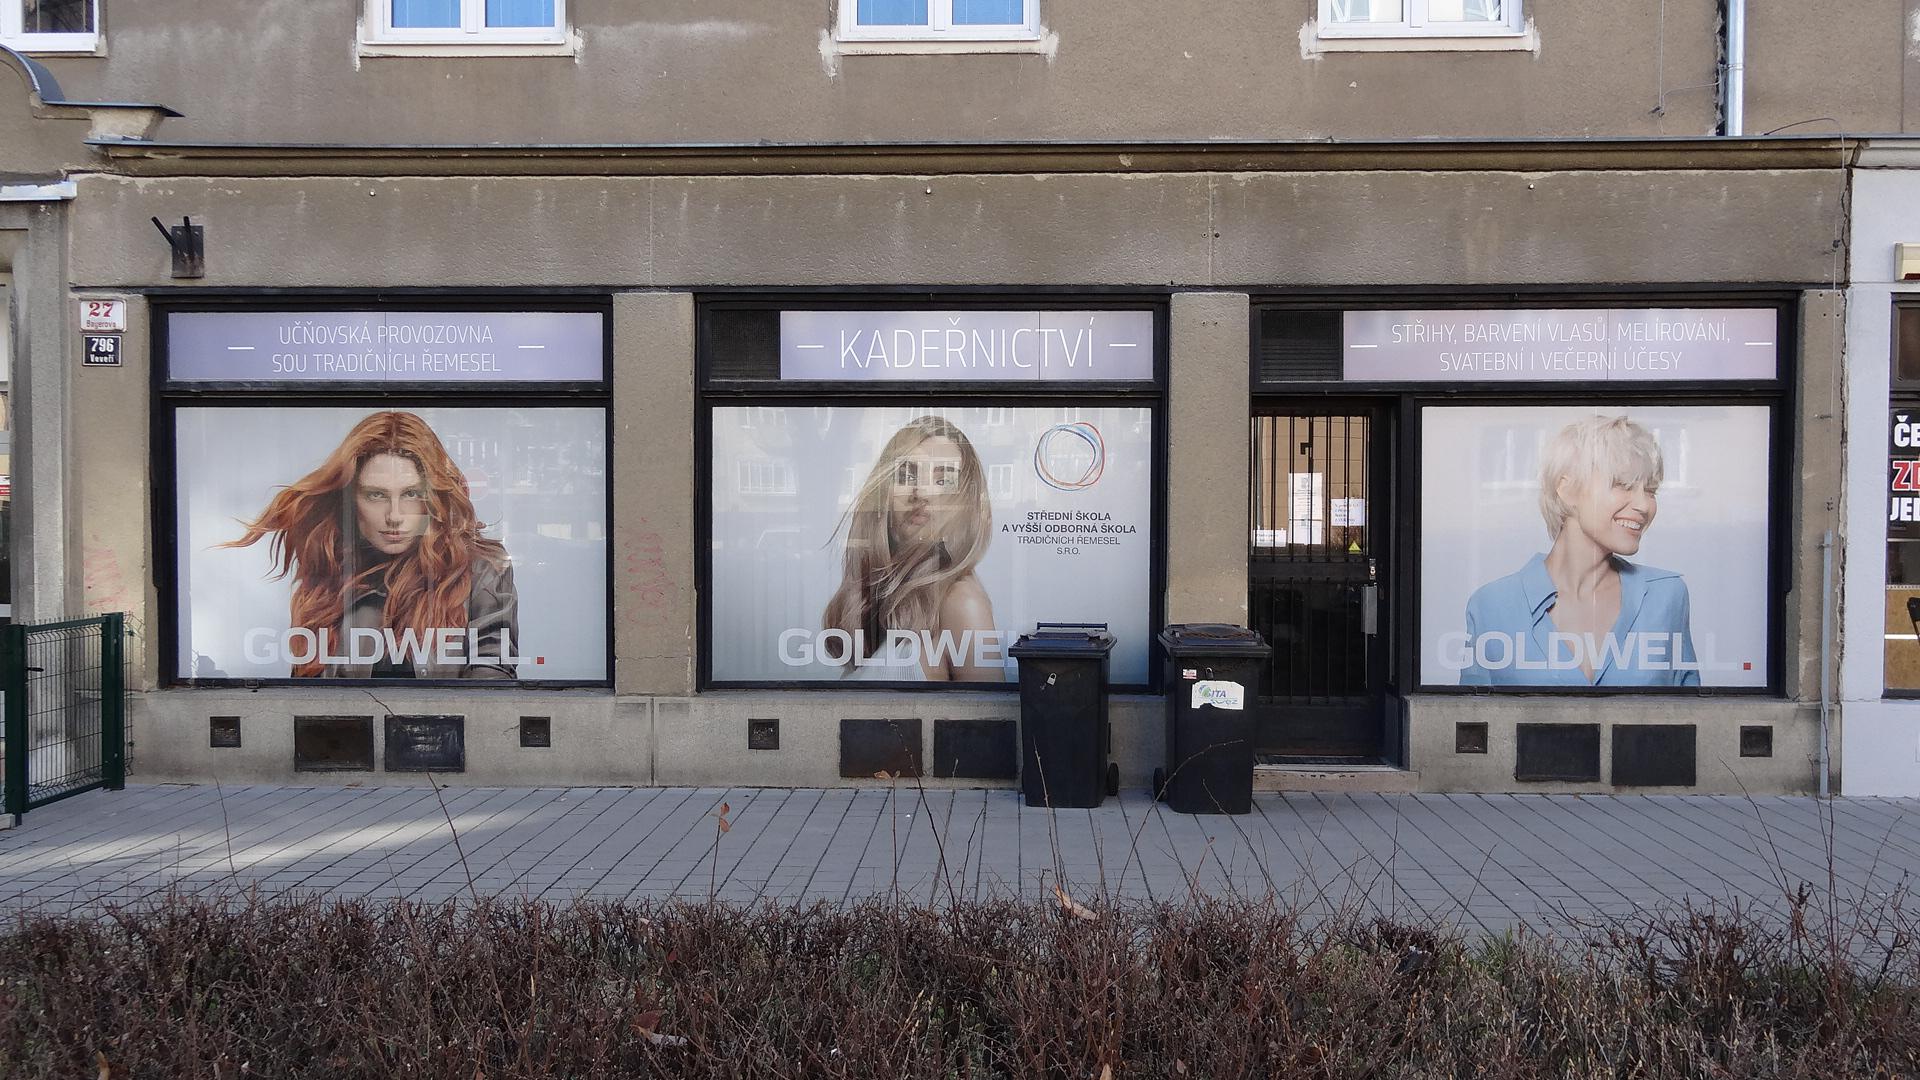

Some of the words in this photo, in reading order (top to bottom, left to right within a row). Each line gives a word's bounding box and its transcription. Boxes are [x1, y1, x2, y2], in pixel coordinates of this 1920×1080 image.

[89, 302, 114, 317] 27
[279, 320, 372, 344] UČŇOVSKÁ
[377, 325, 494, 344] PROVOZOVNA
[1391, 318, 1457, 345] STŘIHY,
[1464, 318, 1542, 343] BARVENÍ
[1617, 316, 1731, 343] MELÍROVÁNÍ,
[91, 337, 114, 352] 796
[840, 316, 1095, 369] KADEŘNICTVÍ
[272, 353, 307, 373] SOU
[313, 348, 415, 372] TRADIČNÍCH
[422, 349, 502, 372] ŘEMESEL
[1439, 347, 1524, 372] SVATEBNÍ
[1531, 352, 1535, 371] I
[1541, 346, 1617, 371] VEČERNÍ
[1624, 346, 1683, 371] ÚČESY
[1027, 510, 1073, 521] STŘEDNÍ
[1075, 510, 1112, 521] ŠKOLA
[1001, 524, 1010, 533] A
[1012, 522, 1042, 533] VYŠŠÍ
[1044, 523, 1098, 533] ODBORNÁ
[1101, 523, 1137, 534] ŠKOLA
[1017, 535, 1074, 545] TRADIČNÍCH
[1077, 535, 1121, 545] ŘEMESEL
[1057, 547, 1081, 555] S.R.O.
